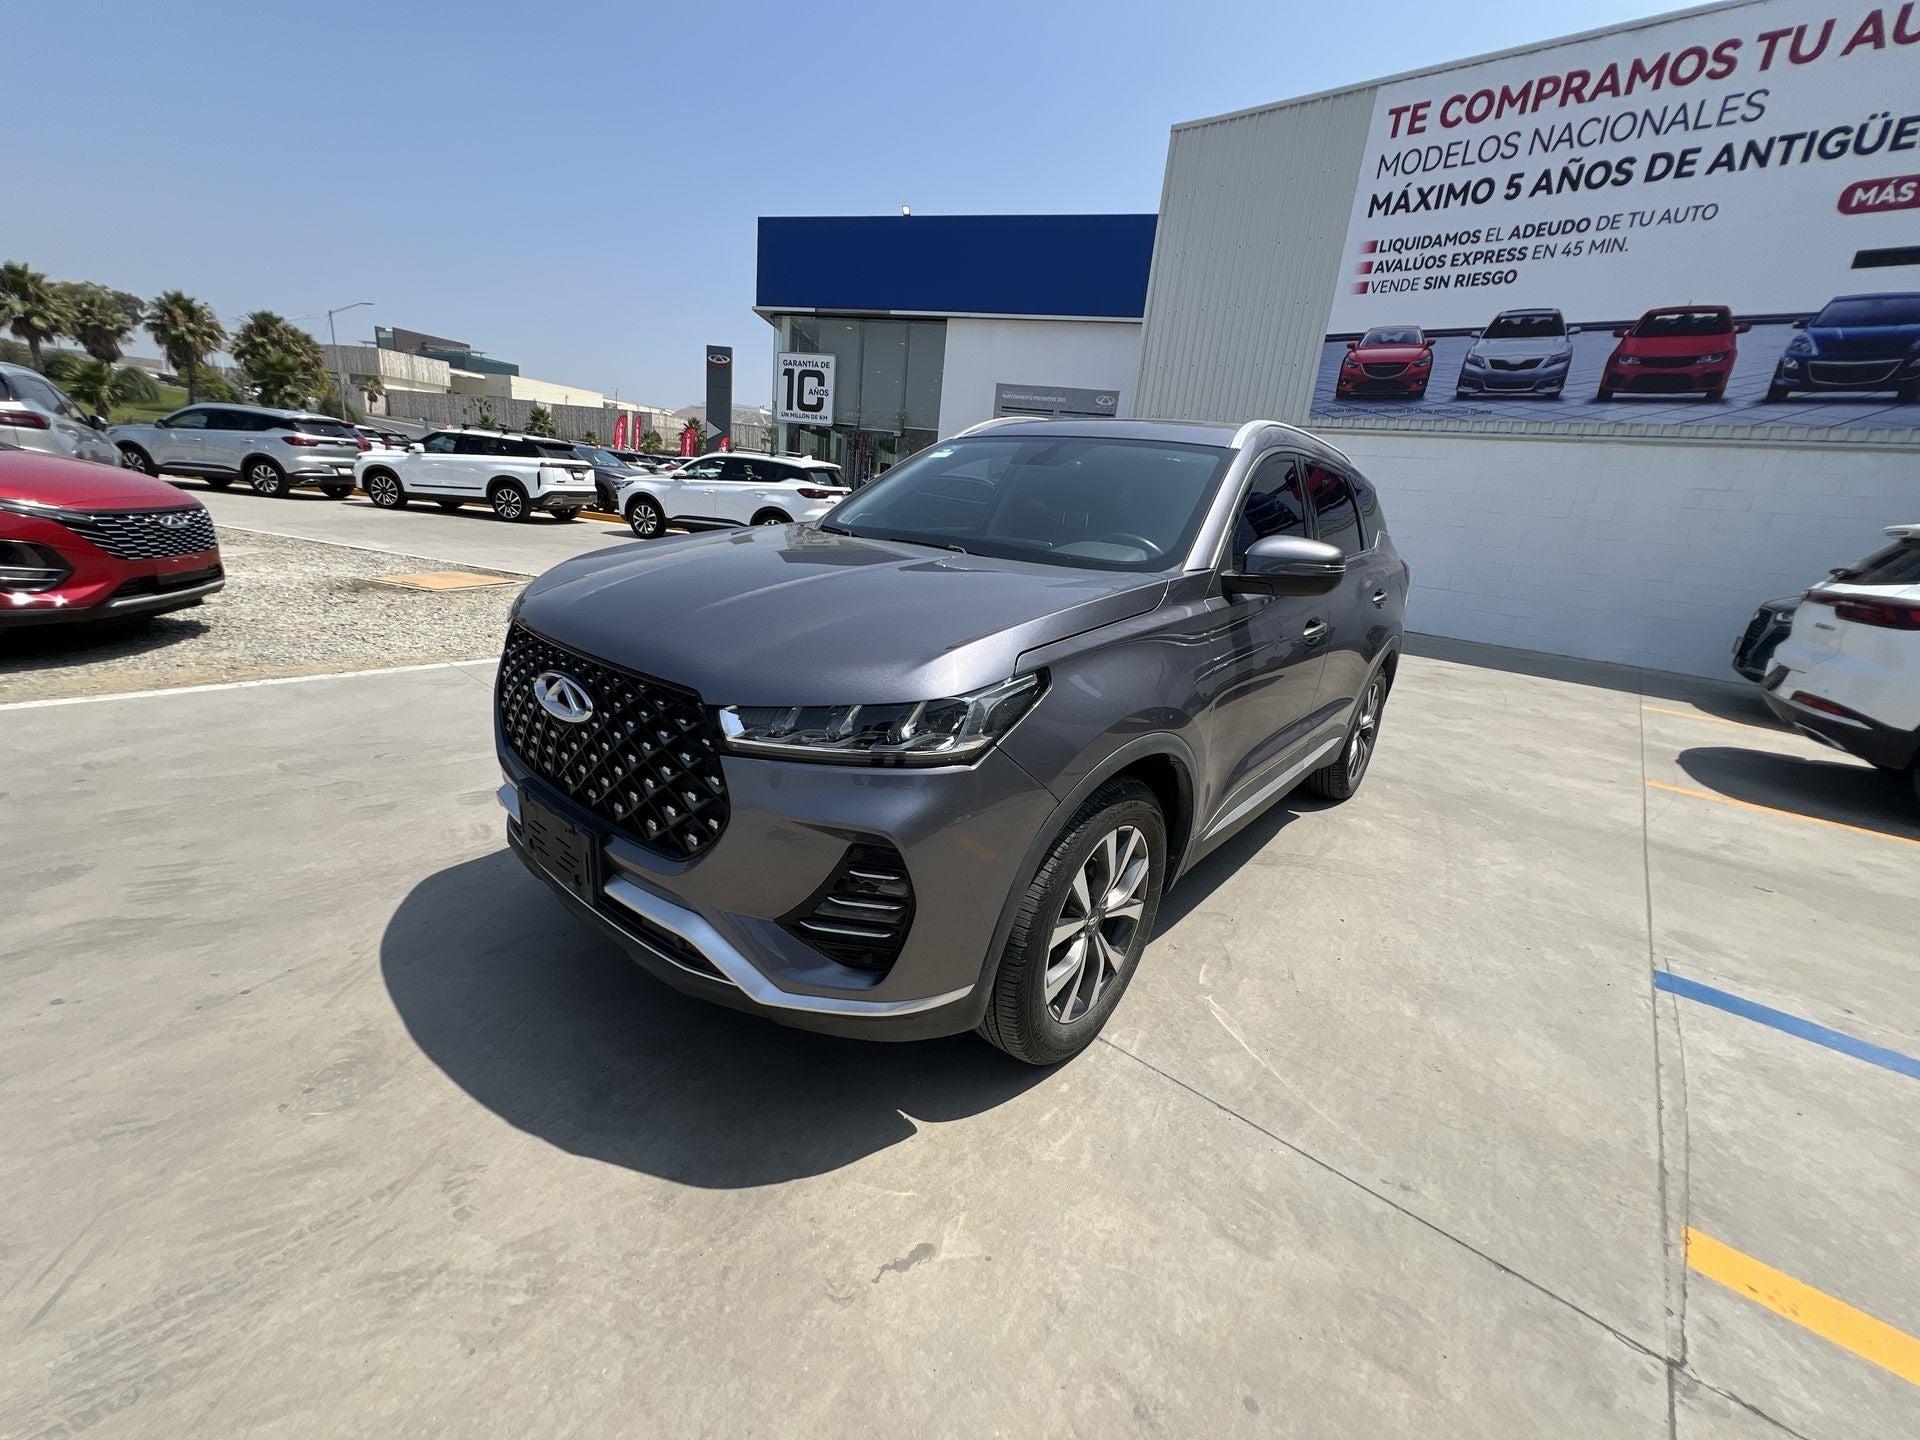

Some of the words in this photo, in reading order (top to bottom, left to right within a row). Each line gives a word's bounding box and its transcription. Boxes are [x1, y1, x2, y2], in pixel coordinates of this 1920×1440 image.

[1388, 100, 1431, 139] TE
[1439, 38, 1743, 129] COMPRAMOS
[1756, 18, 1837, 72] TU
[1376, 130, 1522, 180] MODELOS
[1528, 88, 1770, 156] NACIONALES
[1367, 176, 1496, 218] MÁXIMO
[1503, 171, 1525, 201] 5
[1528, 155, 1638, 198] AÑOS
[1643, 147, 1702, 183] DE
[1849, 178, 1918, 208] MÁS
[1378, 229, 1481, 254] LIQUIDAMOS
[1484, 227, 1504, 243] EL
[1507, 217, 1591, 240] ADEUDO
[1595, 213, 1624, 232] DE
[1628, 210, 1656, 228] TU
[1656, 203, 1719, 225] AUTO
[1373, 253, 1447, 275] AVALÚOS
[1450, 246, 1529, 268] EXPRESS
[1531, 243, 1558, 260] EN
[1561, 240, 1585, 257] 45
[1588, 236, 1629, 255] MIN.
[1371, 277, 1420, 294] VENDE
[1423, 274, 1451, 291] SIN
[1454, 269, 1518, 288] RIESGO
[783, 360, 819, 368] GARANTÍA
[783, 368, 825, 412] 10
[808, 387, 829, 396] AÑOS
